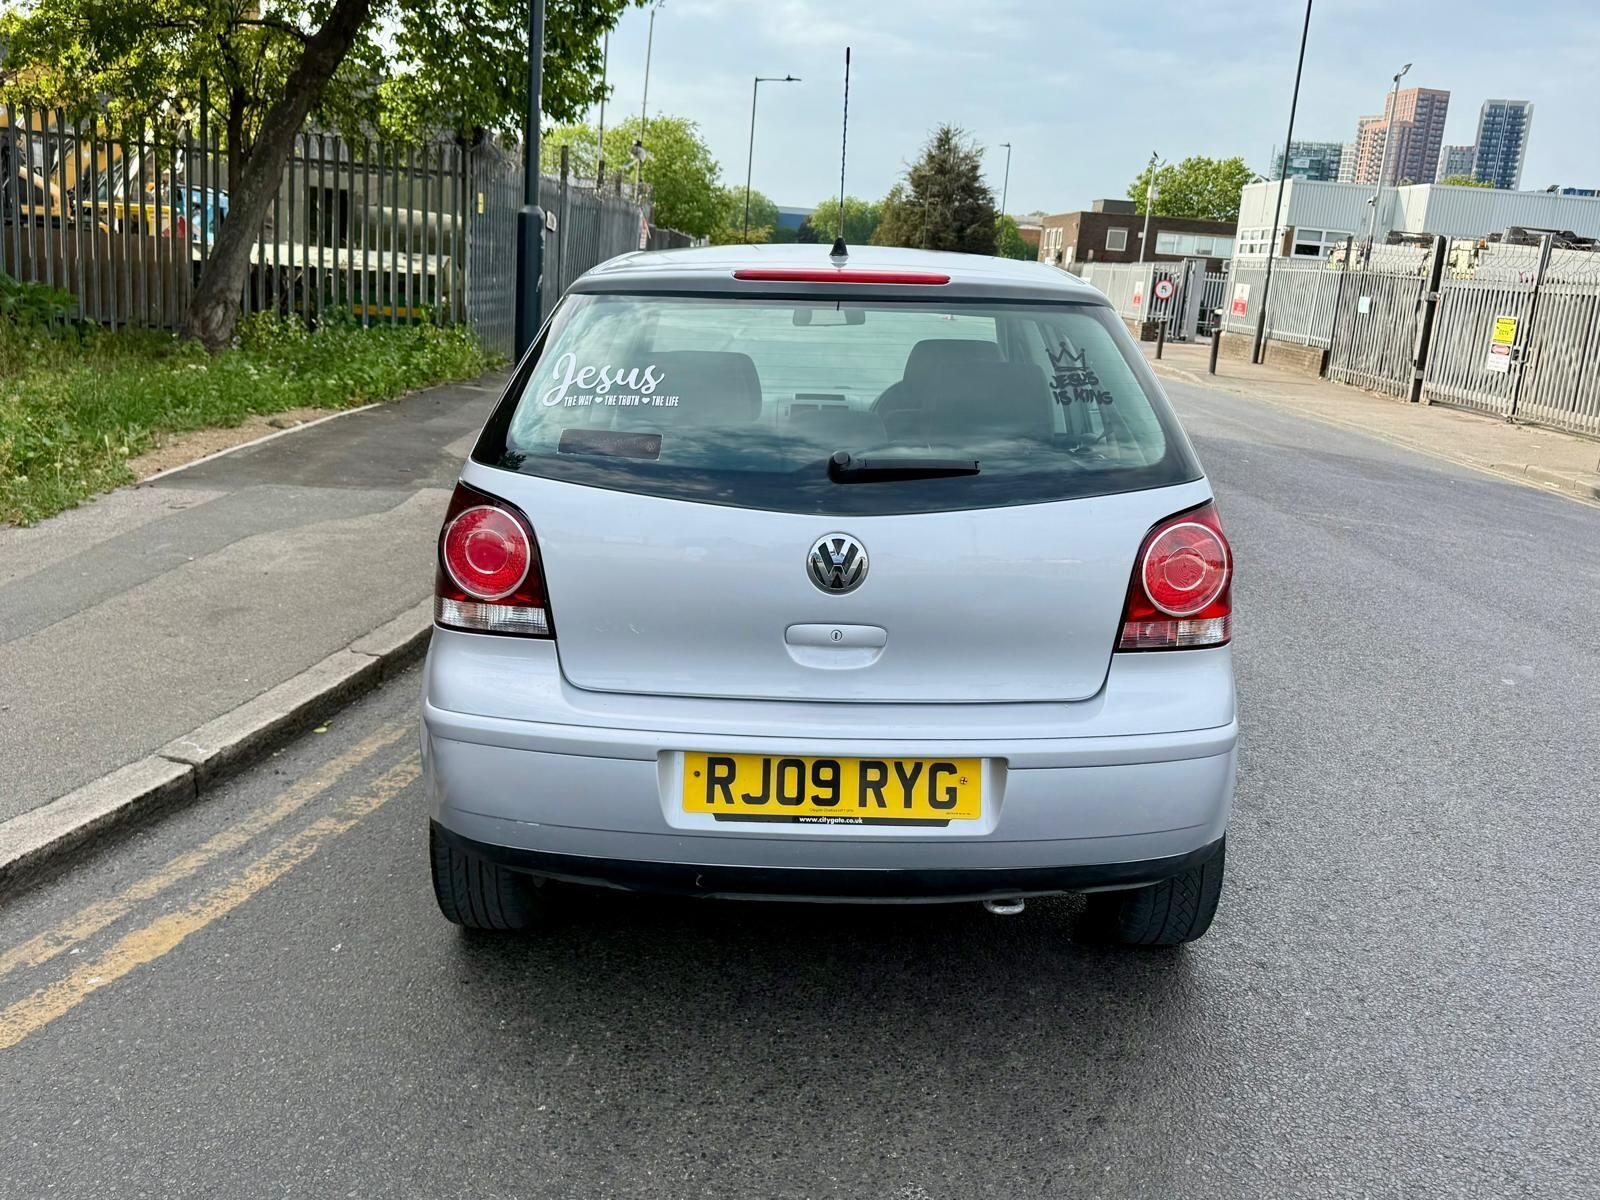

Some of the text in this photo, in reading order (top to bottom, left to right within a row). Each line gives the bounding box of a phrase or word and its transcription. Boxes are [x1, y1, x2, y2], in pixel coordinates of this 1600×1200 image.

[1161, 285, 1167, 294] 5
[543, 352, 665, 407] Jesus
[564, 395, 680, 407] THE WAY THE TRUTH THE LIFE
[1053, 389, 1113, 405] IS KING
[706, 756, 958, 810] RJ09 RYG
[799, 817, 863, 825] www.citygate.co.uk
